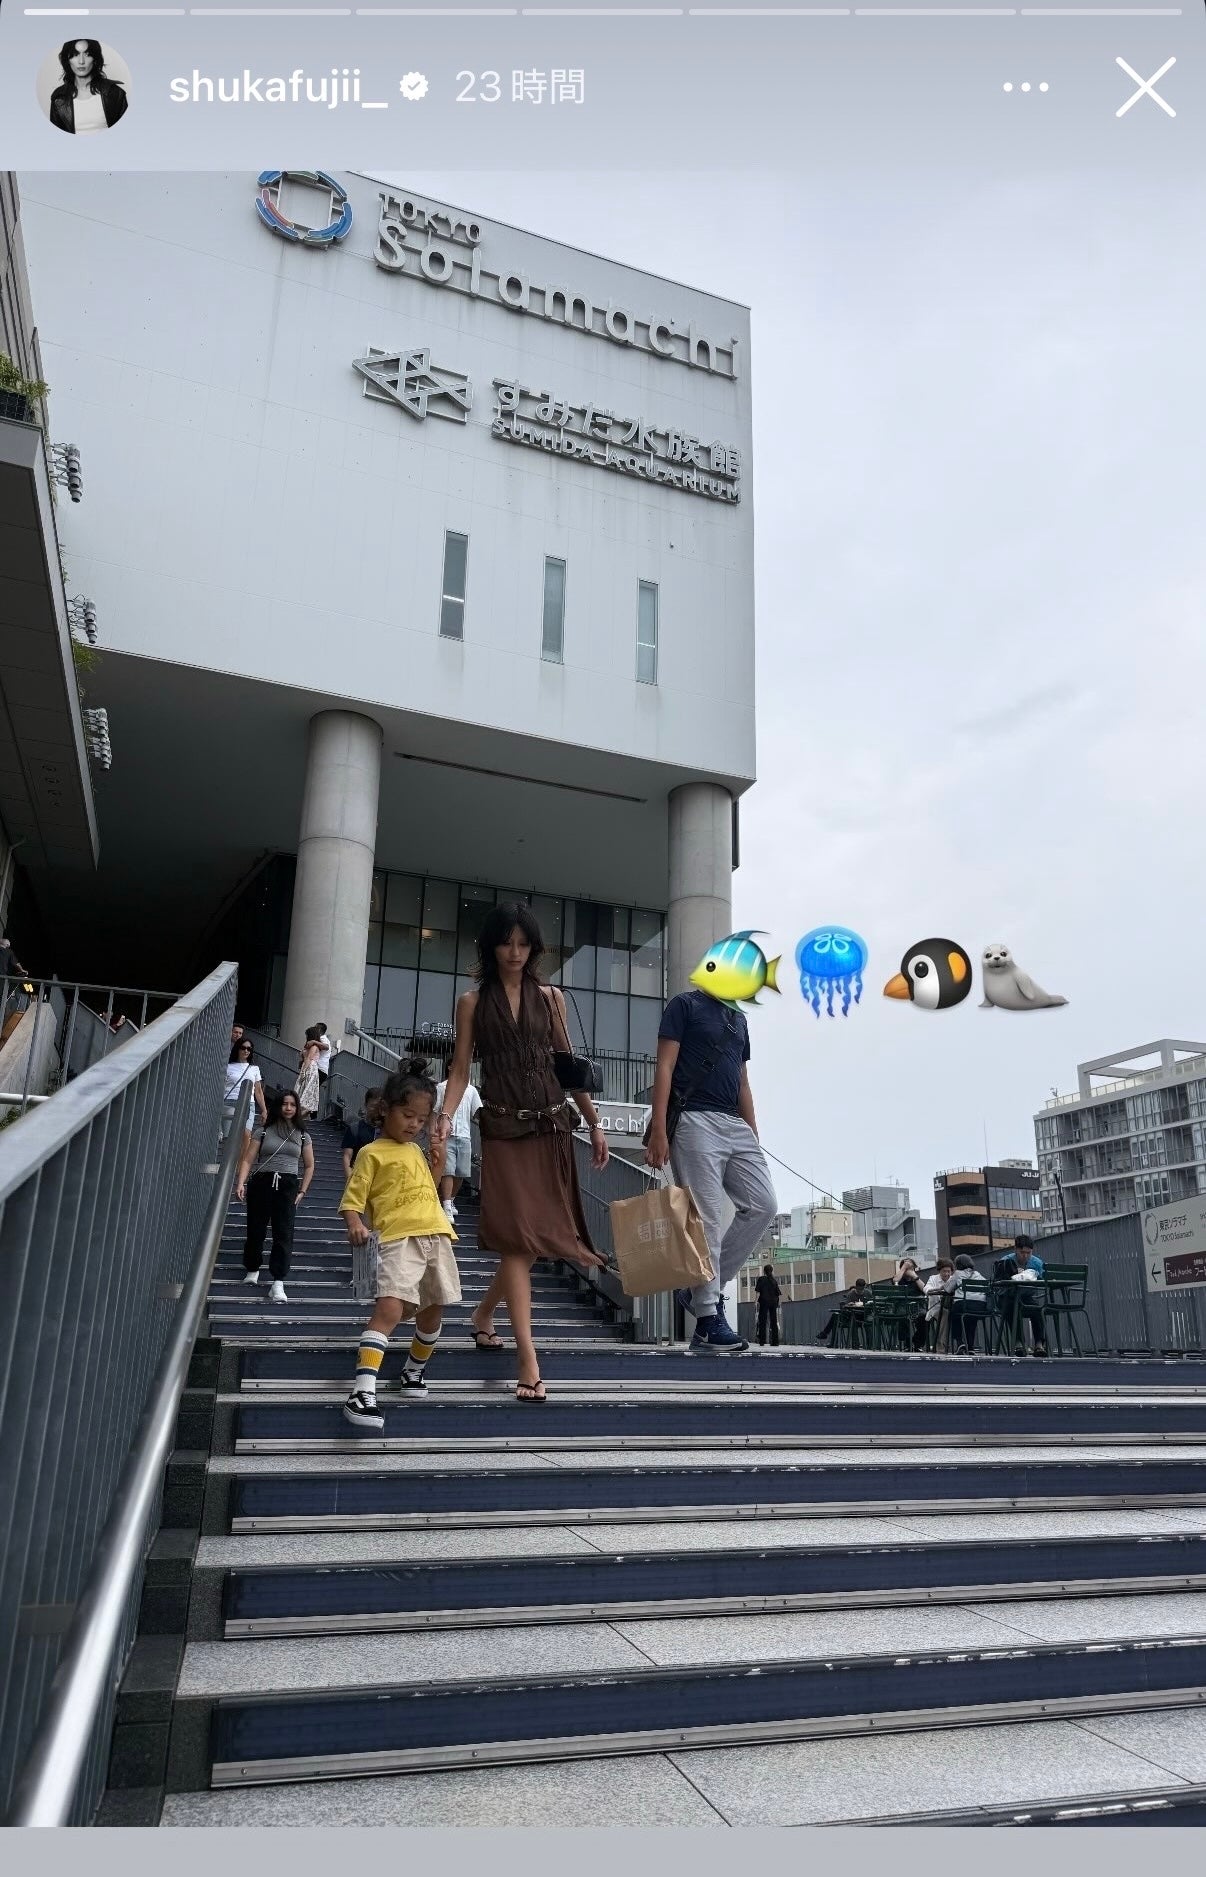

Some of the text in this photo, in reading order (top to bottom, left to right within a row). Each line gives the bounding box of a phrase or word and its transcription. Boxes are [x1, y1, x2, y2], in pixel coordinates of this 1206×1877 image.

[378, 193, 481, 244] TOKYO
[373, 218, 738, 381] Solamachi
[491, 377, 742, 480] すみだ水族館
[491, 417, 742, 505] SUMIDA AQUARIUM
